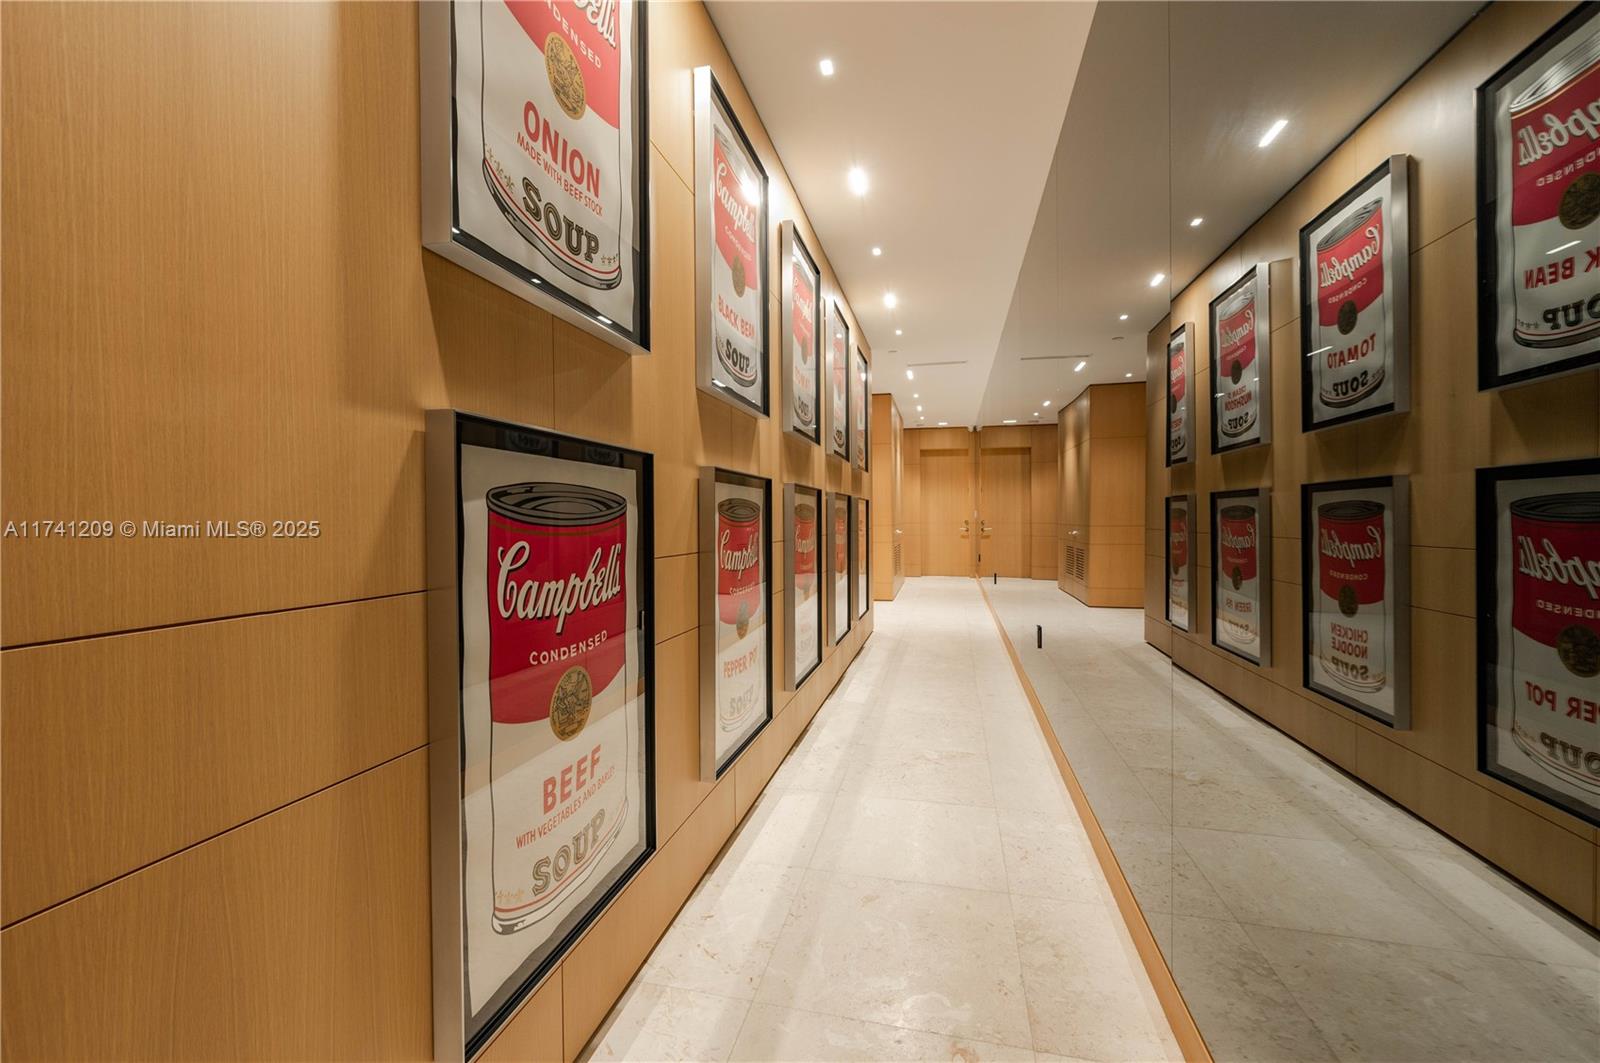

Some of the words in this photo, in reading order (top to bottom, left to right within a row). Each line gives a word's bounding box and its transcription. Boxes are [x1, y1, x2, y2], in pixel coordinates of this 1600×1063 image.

[517, 132, 542, 166] MADE
[543, 158, 562, 186] WITH
[563, 179, 583, 203] BEEF
[584, 195, 604, 217] STOCK
[523, 100, 600, 198] ONION
[522, 176, 600, 264] SOUP
[718, 293, 738, 331] BLACK
[725, 338, 750, 374] SOUP
[529, 630, 608, 666] CONDENSED
[515, 828, 536, 849] WITH
[538, 796, 581, 839] VEGETABLES
[582, 783, 597, 804] AND
[543, 744, 602, 816] BEEF
[531, 808, 606, 897] SOUP
